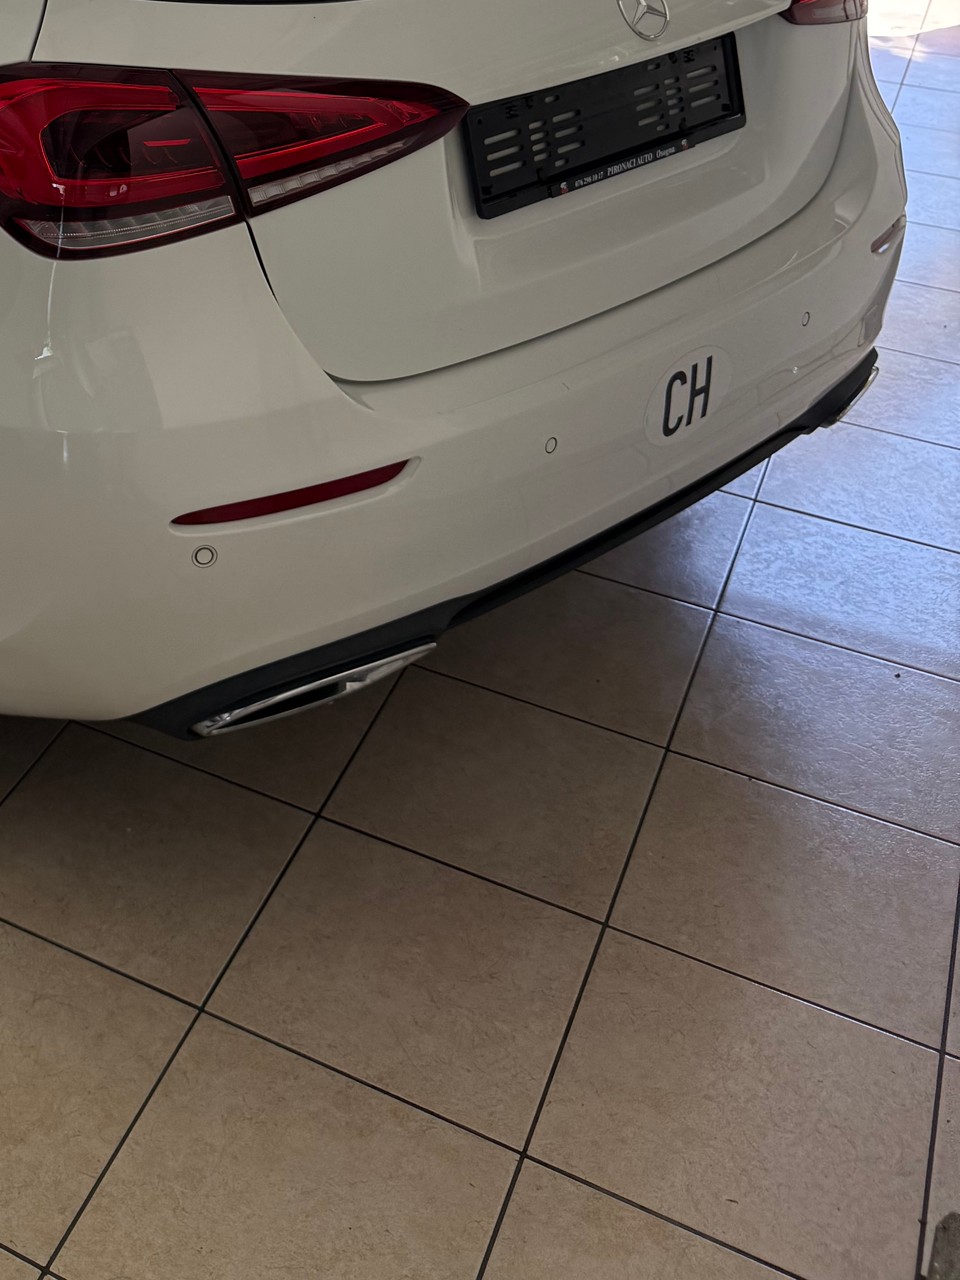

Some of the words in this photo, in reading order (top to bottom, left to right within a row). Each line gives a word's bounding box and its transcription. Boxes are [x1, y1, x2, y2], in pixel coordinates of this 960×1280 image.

[607, 159, 636, 176] PIRONACI
[636, 152, 653, 165] AUTO
[662, 355, 713, 437] CH
